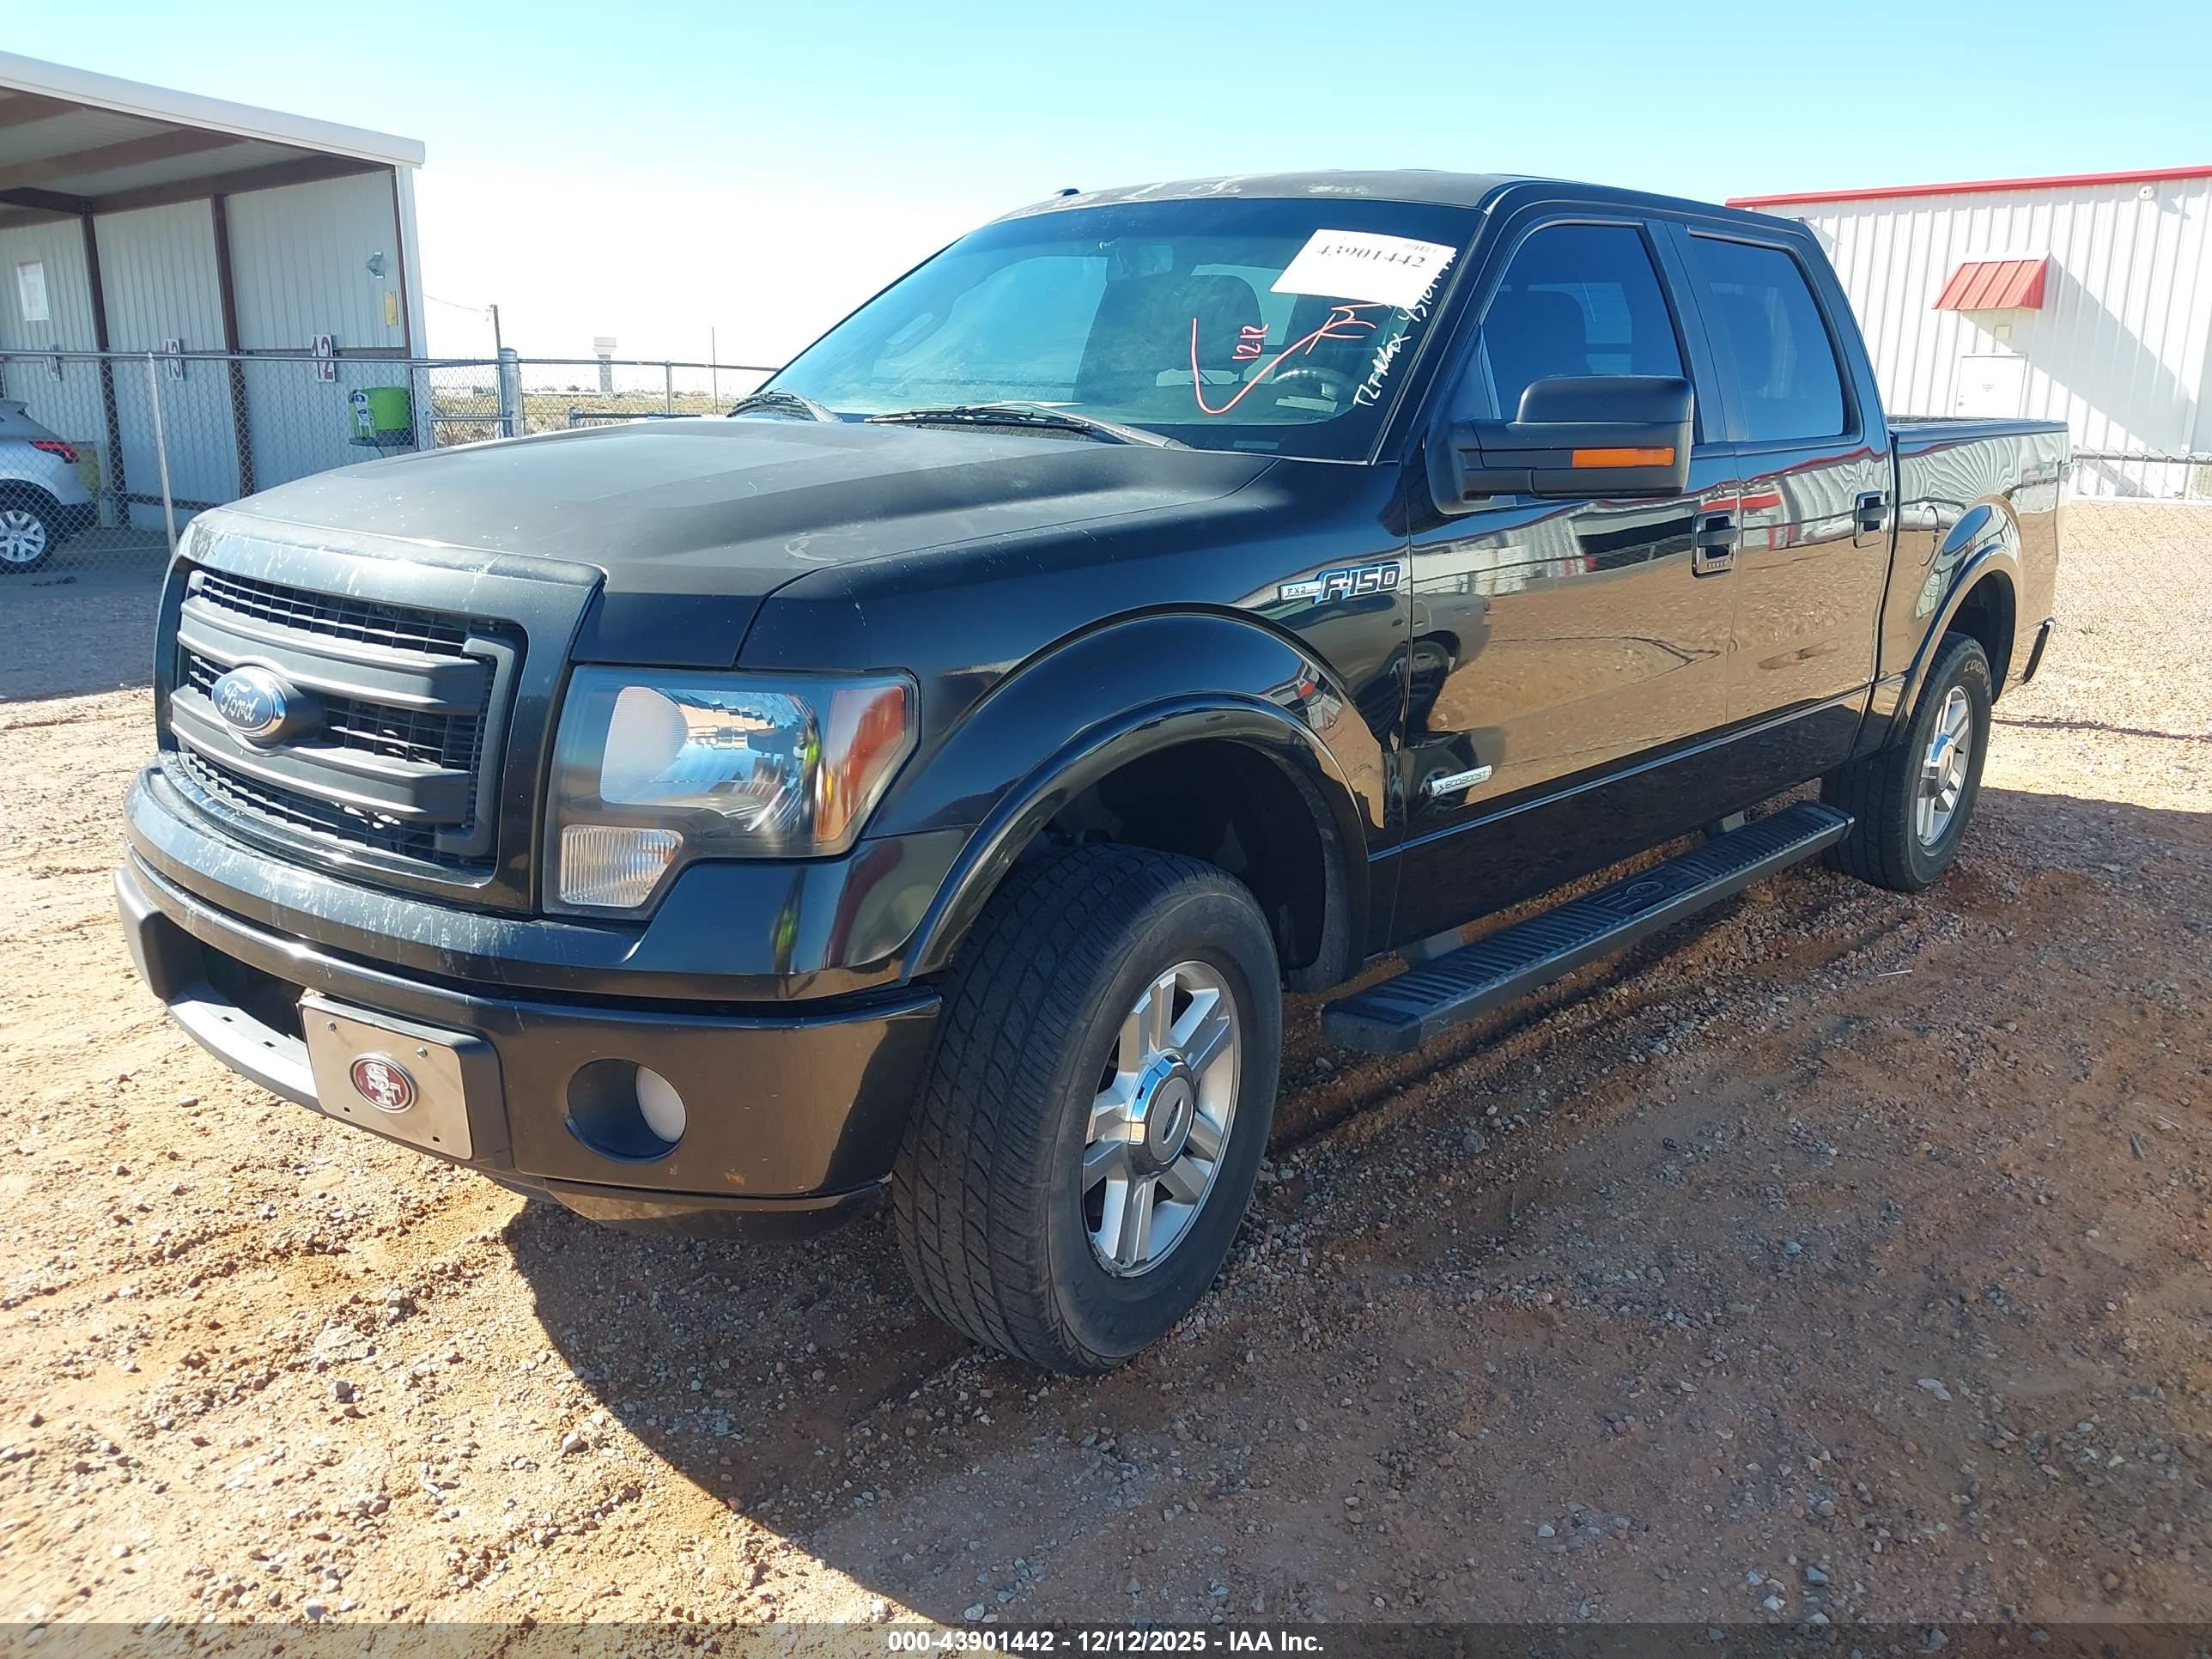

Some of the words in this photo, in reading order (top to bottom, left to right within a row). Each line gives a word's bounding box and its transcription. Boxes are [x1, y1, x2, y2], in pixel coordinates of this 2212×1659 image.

[1317, 246, 1425, 267] 43901442
[164, 340, 181, 379] 13
[312, 336, 334, 380] 12
[1322, 562, 1401, 604] F-150
[219, 679, 261, 722] Ford
[1444, 770, 1487, 789] ECOBOOST
